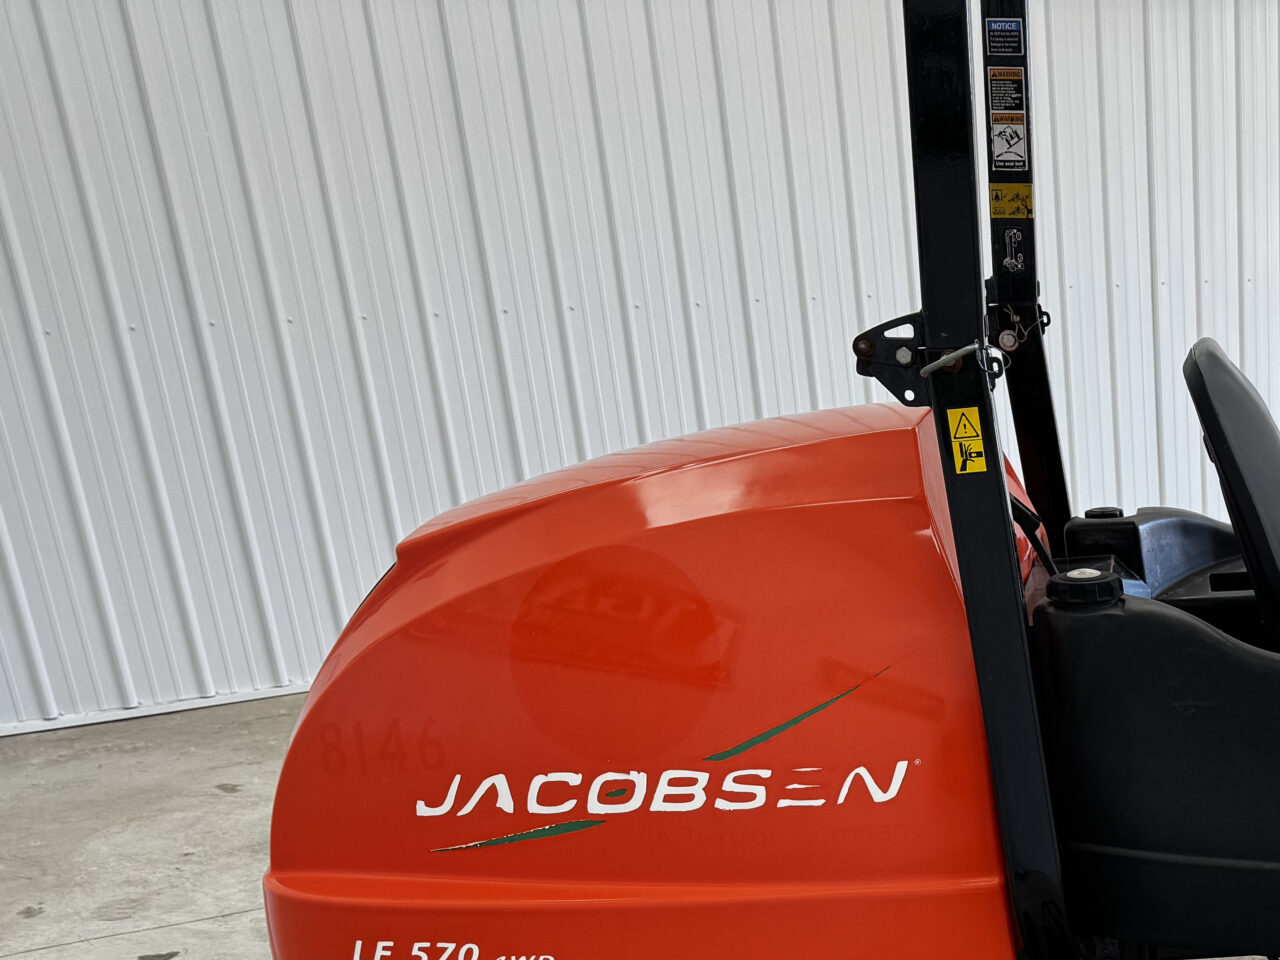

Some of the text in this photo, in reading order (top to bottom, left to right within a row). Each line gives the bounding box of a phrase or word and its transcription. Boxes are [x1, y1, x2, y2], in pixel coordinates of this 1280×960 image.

[991, 22, 1017, 30] NOTICE
[320, 717, 446, 777] 8146
[416, 760, 909, 817] JACOBSEN
